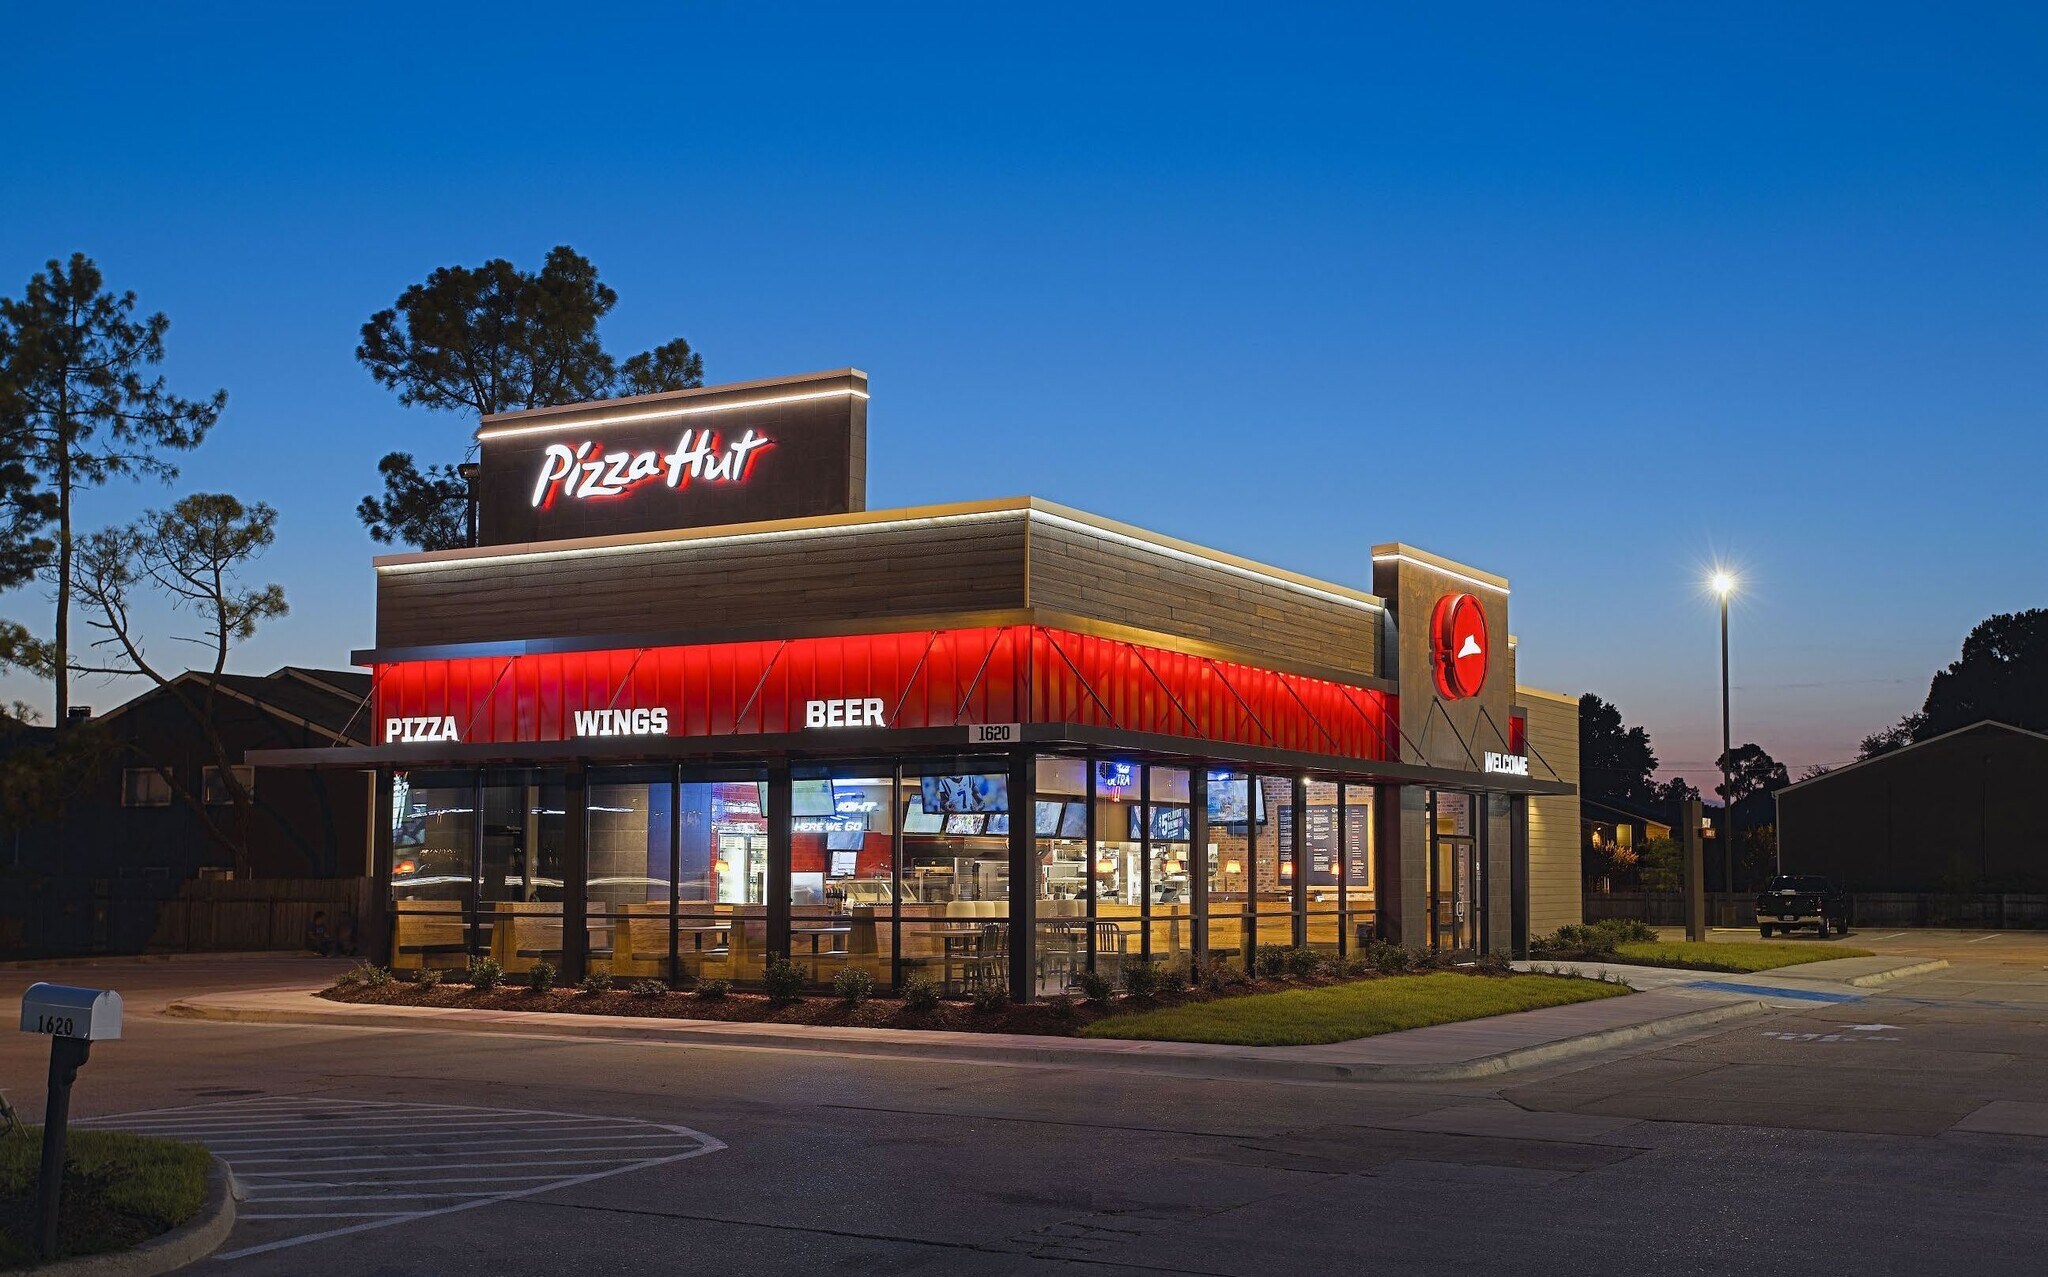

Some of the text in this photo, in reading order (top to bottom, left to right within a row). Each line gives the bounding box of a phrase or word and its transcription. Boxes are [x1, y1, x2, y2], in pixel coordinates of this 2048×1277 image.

[532, 428, 771, 508] Pizza Hut
[574, 707, 669, 737] WINGS
[805, 697, 886, 728] BEER
[386, 715, 460, 743] PIZZA
[977, 725, 1011, 742] 1620
[1484, 751, 1529, 776] WELCOME
[956, 789, 967, 809] 7
[793, 820, 863, 832] HERE WE GO
[38, 1014, 74, 1036] 1620
